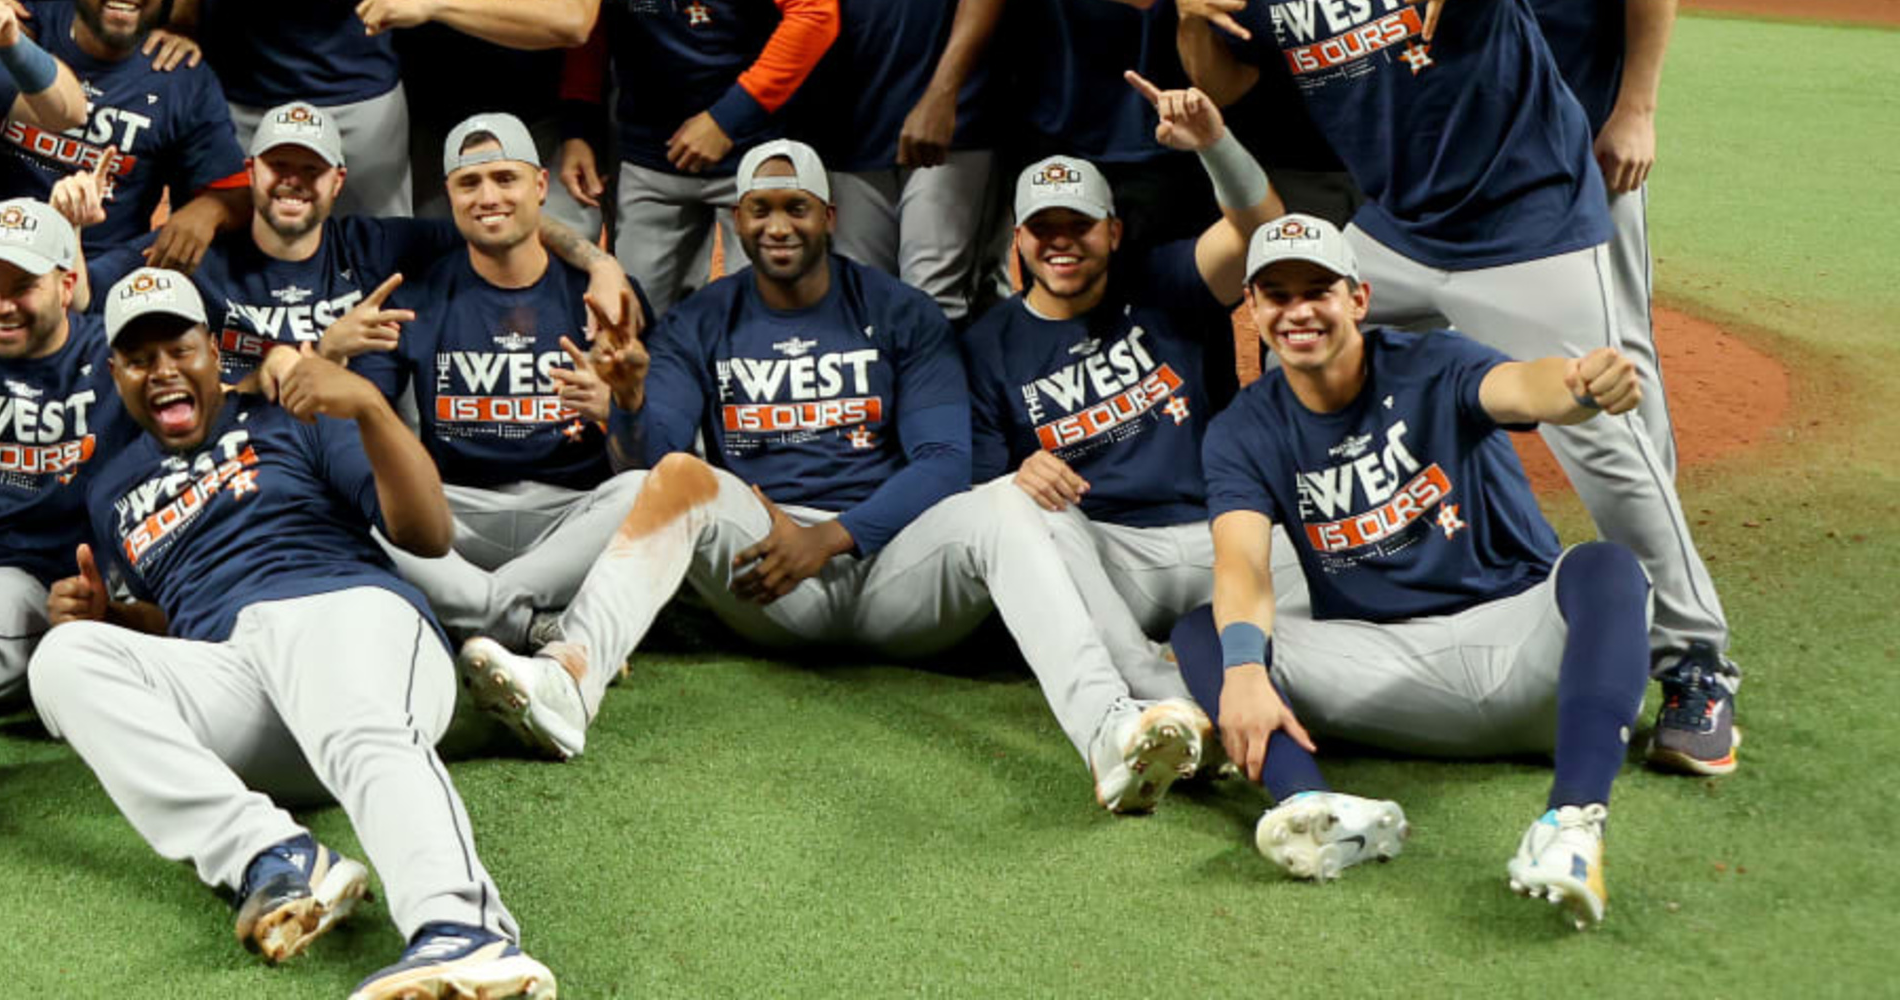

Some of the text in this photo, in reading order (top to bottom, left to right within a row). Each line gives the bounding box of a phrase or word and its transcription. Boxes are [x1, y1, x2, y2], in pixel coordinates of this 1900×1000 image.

[1293, 14, 1409, 73] IS OURS
[436, 352, 451, 392] THE
[731, 348, 880, 403] WEST
[1021, 325, 1156, 425] THE WEST
[450, 398, 479, 420] IS
[737, 400, 868, 430] IS OURS
[1089, 373, 1172, 432] OURS
[1050, 417, 1085, 447] IS
[1303, 420, 1421, 520] WEST
[1355, 475, 1441, 541] OURS
[1317, 523, 1350, 551] IS
